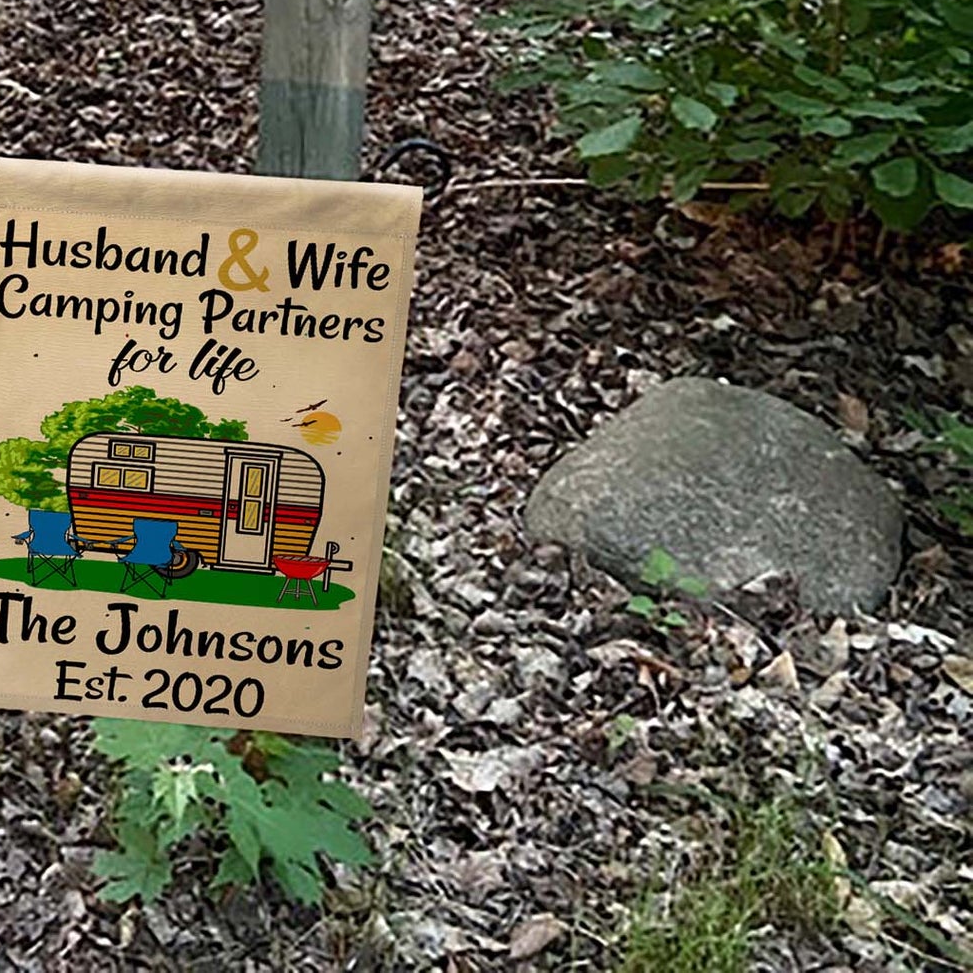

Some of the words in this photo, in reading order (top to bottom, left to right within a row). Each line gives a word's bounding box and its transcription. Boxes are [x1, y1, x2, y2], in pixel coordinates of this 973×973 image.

[0, 219, 210, 278] Husband
[217, 227, 271, 293] &
[287, 239, 391, 291] Wife
[198, 288, 386, 343] Partners
[107, 339, 178, 387] for
[188, 338, 260, 395] life
[95, 602, 345, 670] Johnsons
[53, 660, 133, 703] Est.
[141, 668, 266, 719] 2020
